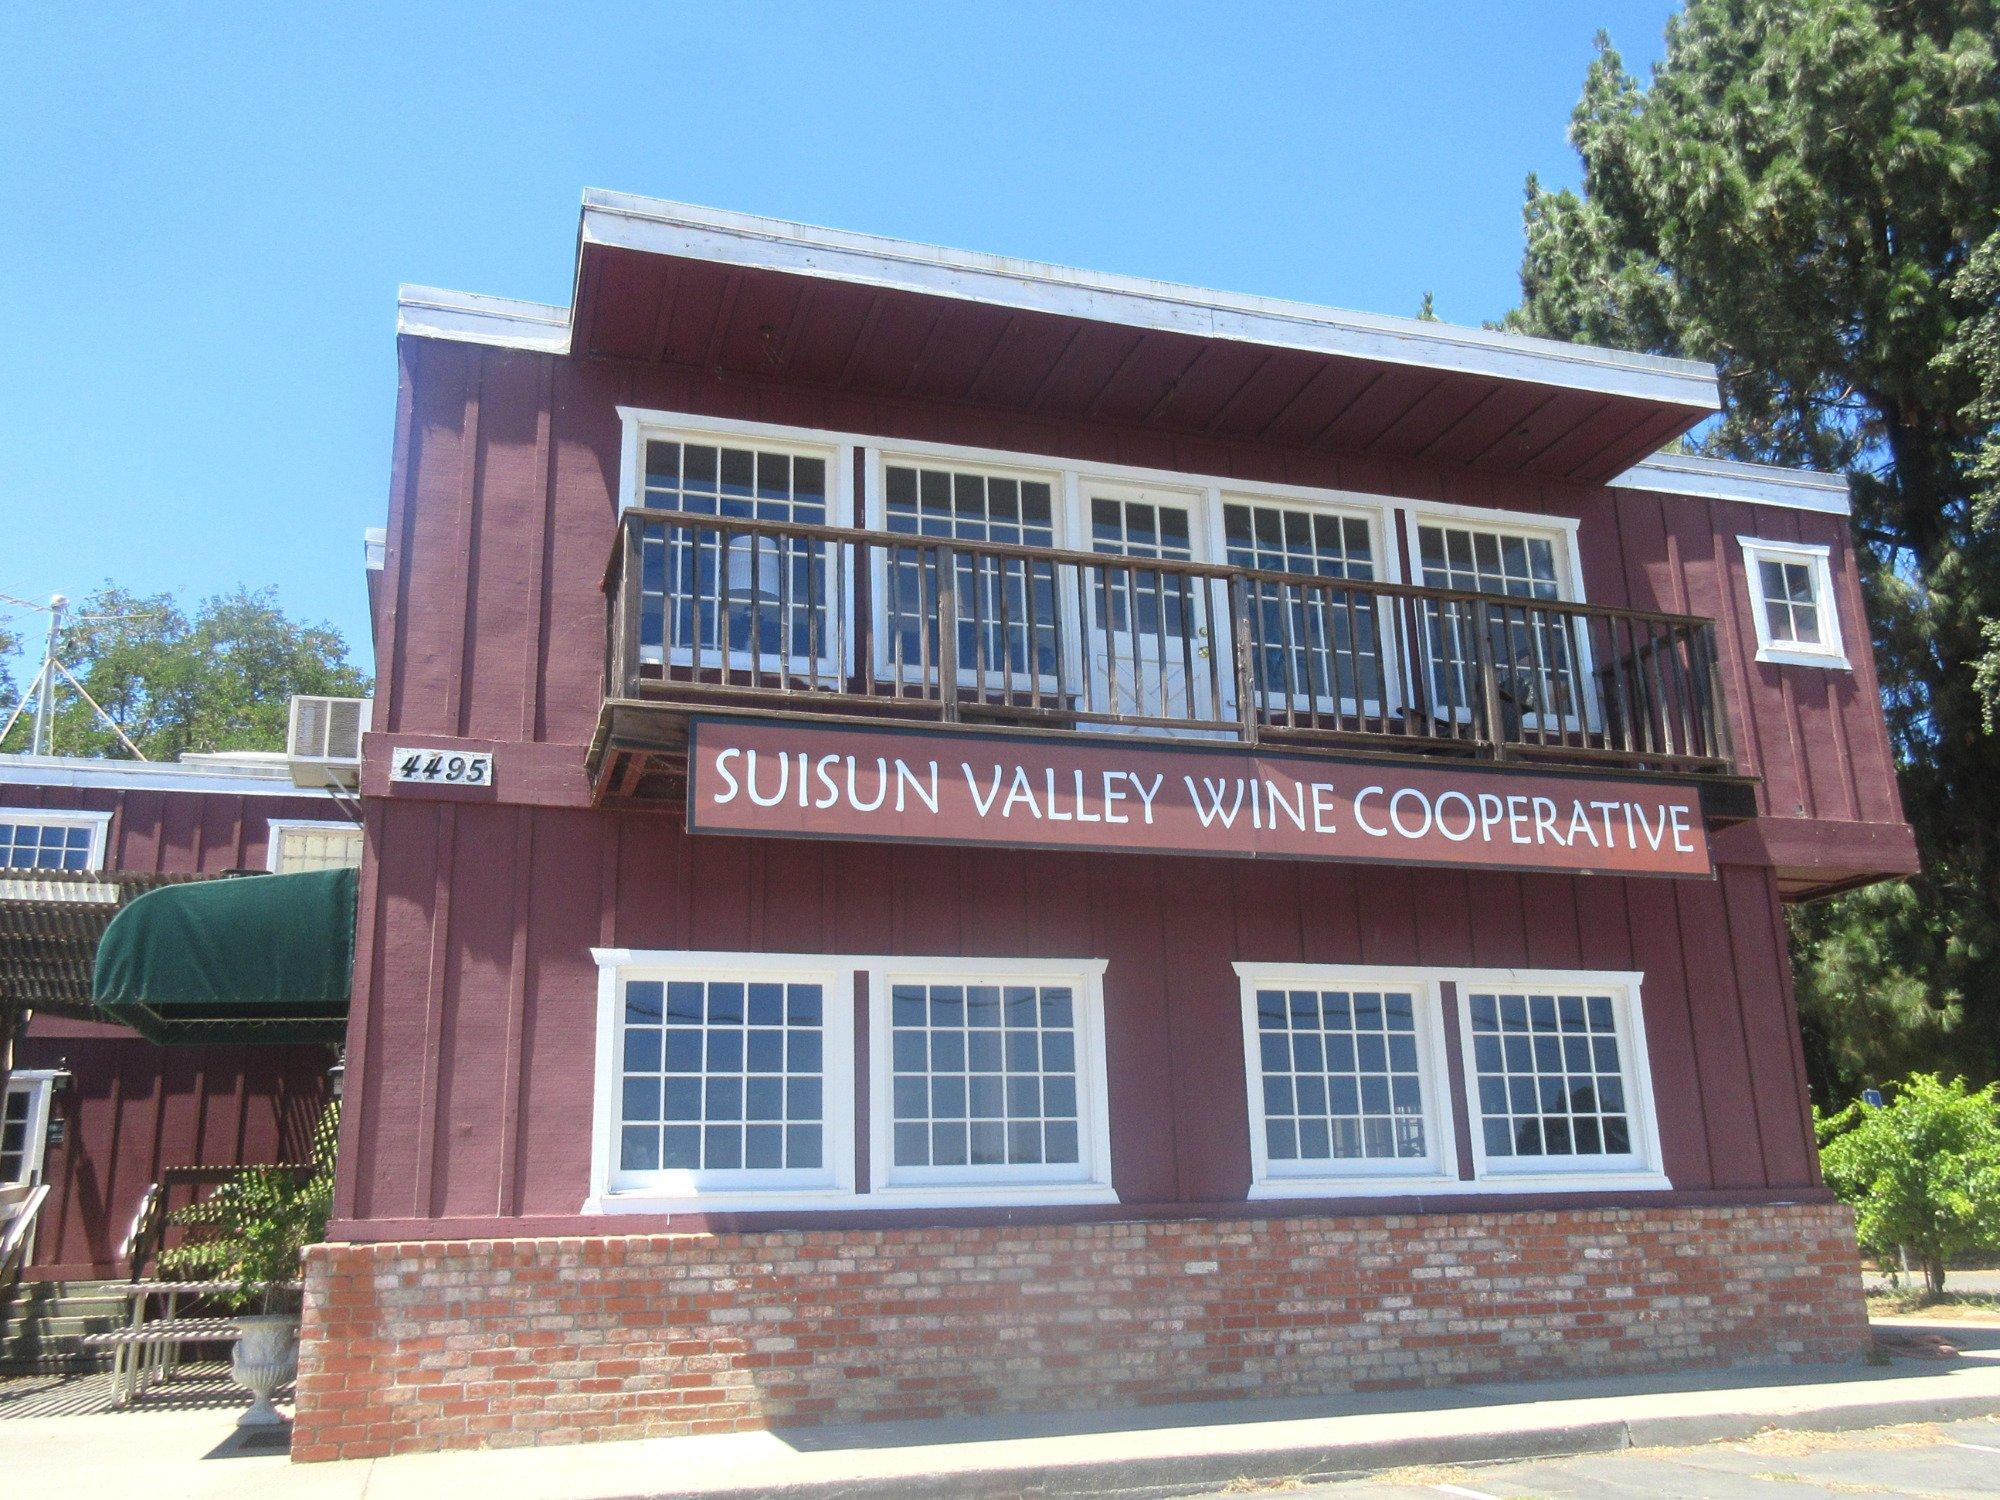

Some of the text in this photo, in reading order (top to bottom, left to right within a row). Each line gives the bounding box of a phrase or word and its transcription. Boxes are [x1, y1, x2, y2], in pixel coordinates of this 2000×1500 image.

[400, 754, 488, 783] 4495
[713, 748, 1695, 853] SUISUN VALLEY WINE COOPERATIVE
